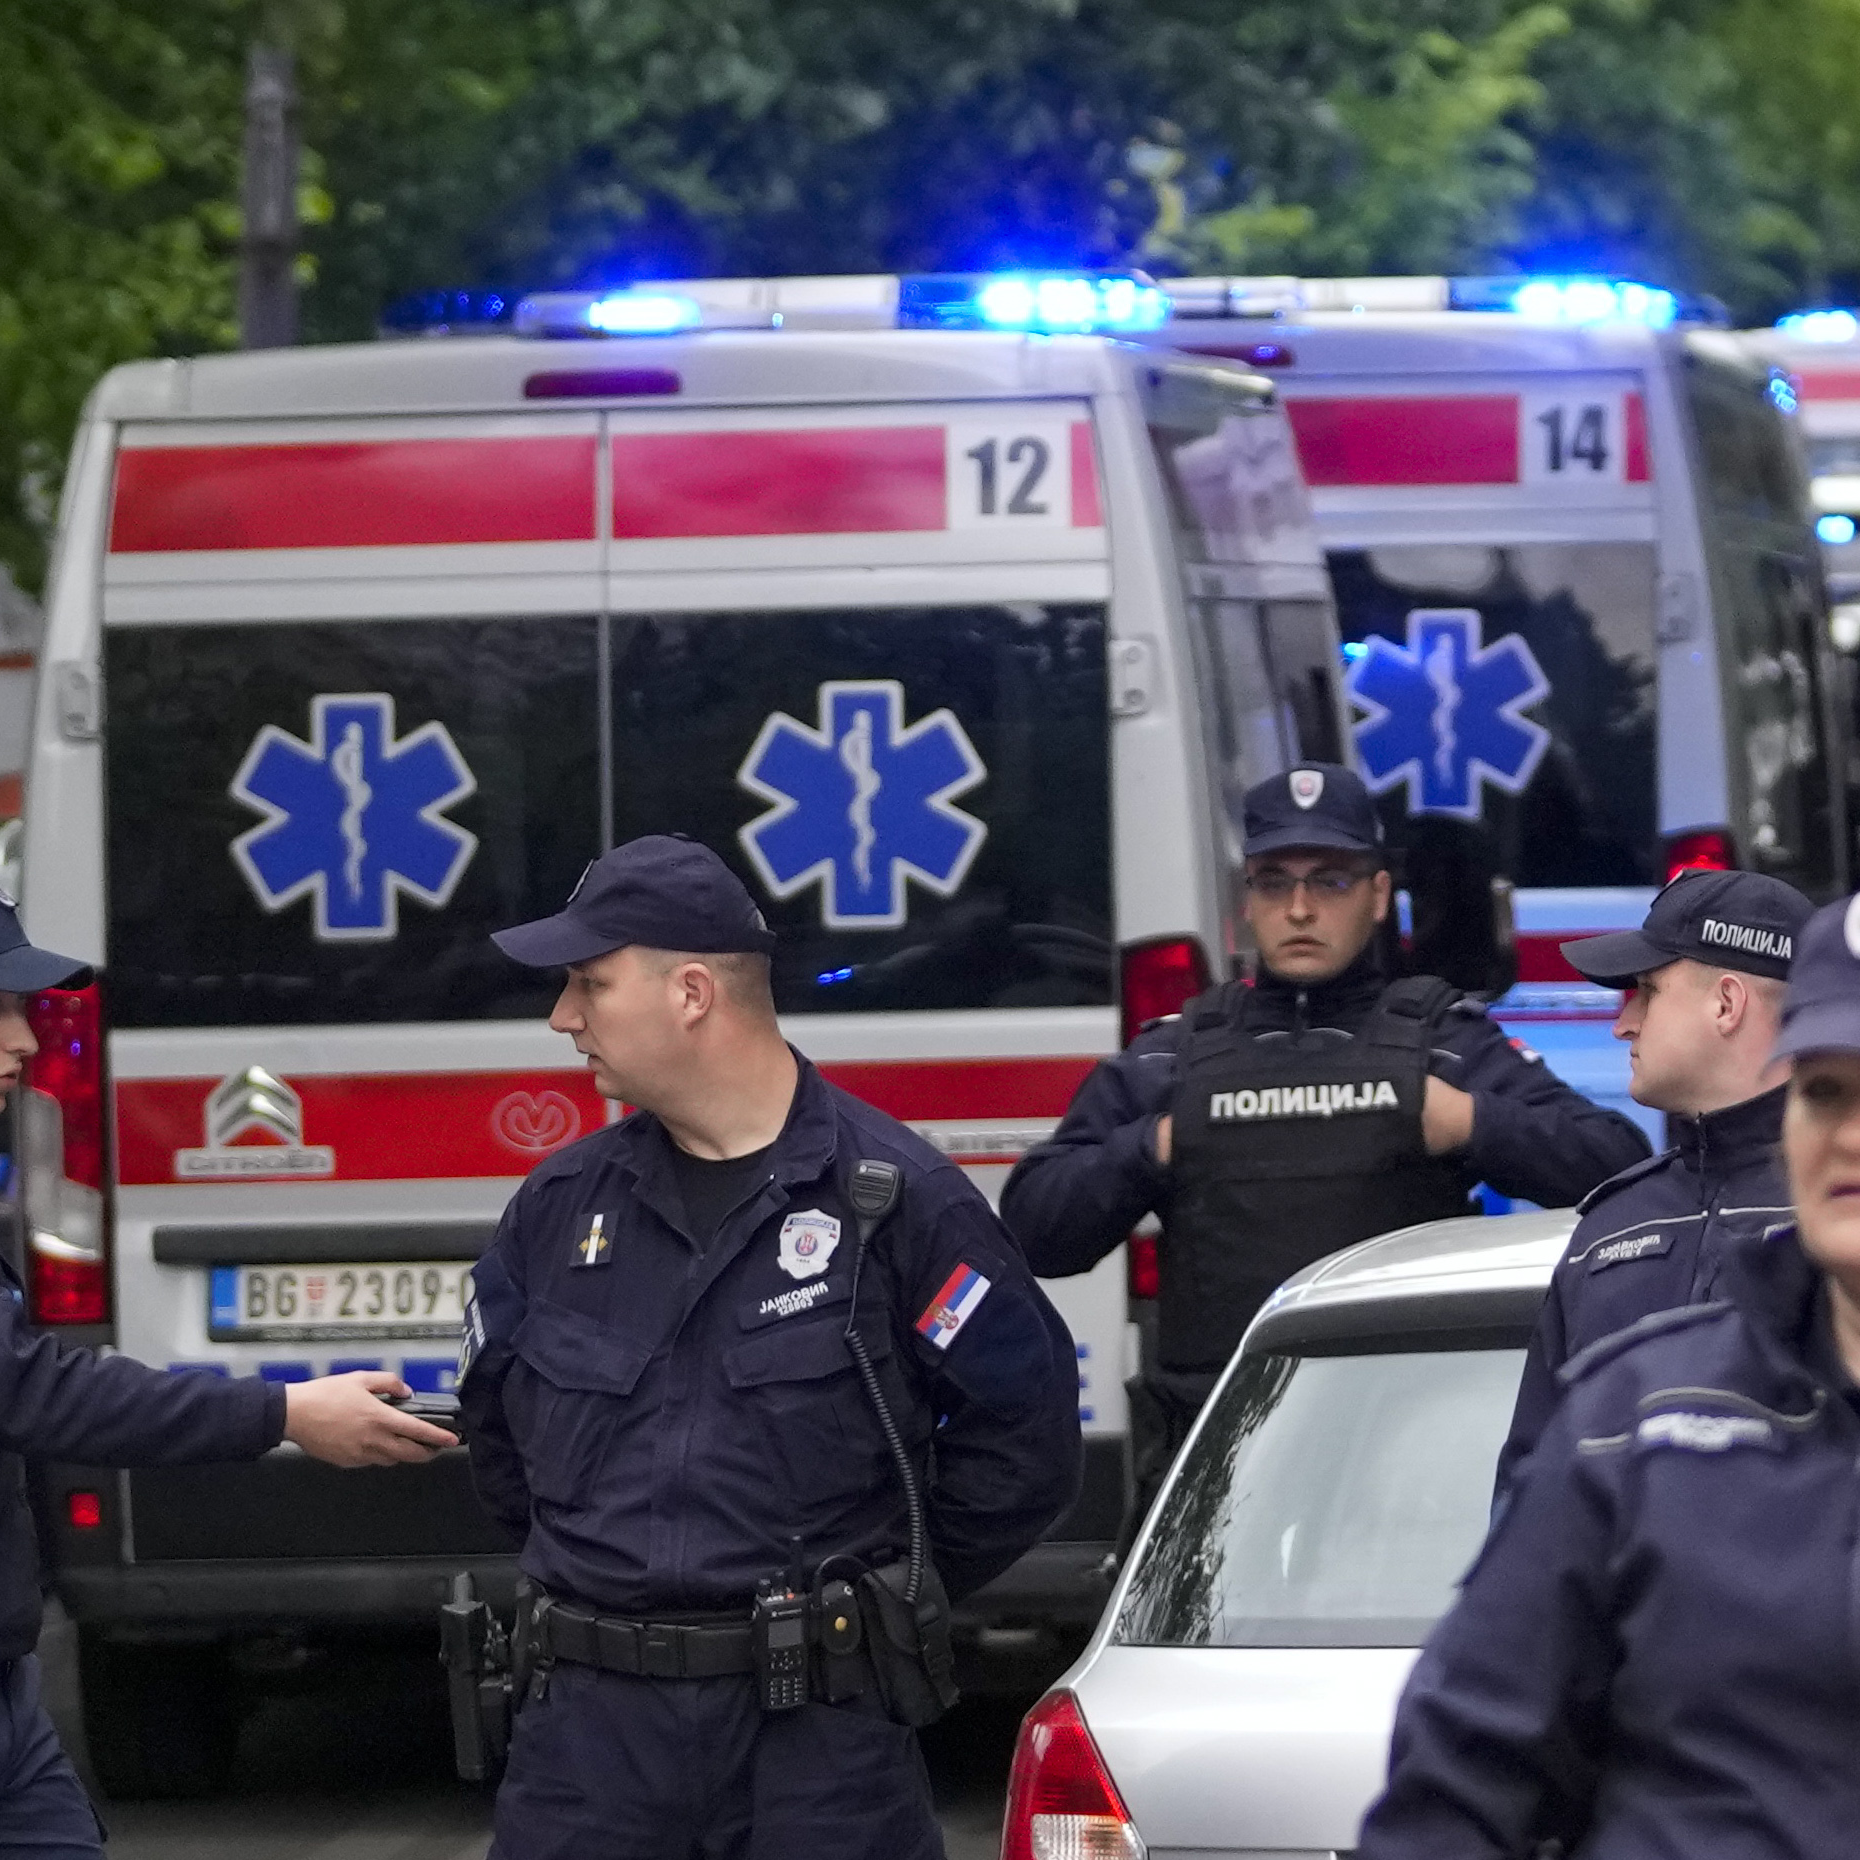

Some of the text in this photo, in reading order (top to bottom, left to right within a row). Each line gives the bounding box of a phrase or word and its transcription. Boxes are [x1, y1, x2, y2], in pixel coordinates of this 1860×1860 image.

[1537, 404, 1608, 470] 14
[967, 436, 1049, 514] 12
[1702, 919, 1792, 959] ПОЛИЦИЈА
[1210, 1081, 1399, 1117] ПОЛИЦИЈА
[247, 1272, 297, 1318] BG
[759, 1281, 829, 1314] ЈАНКОВИЋ
